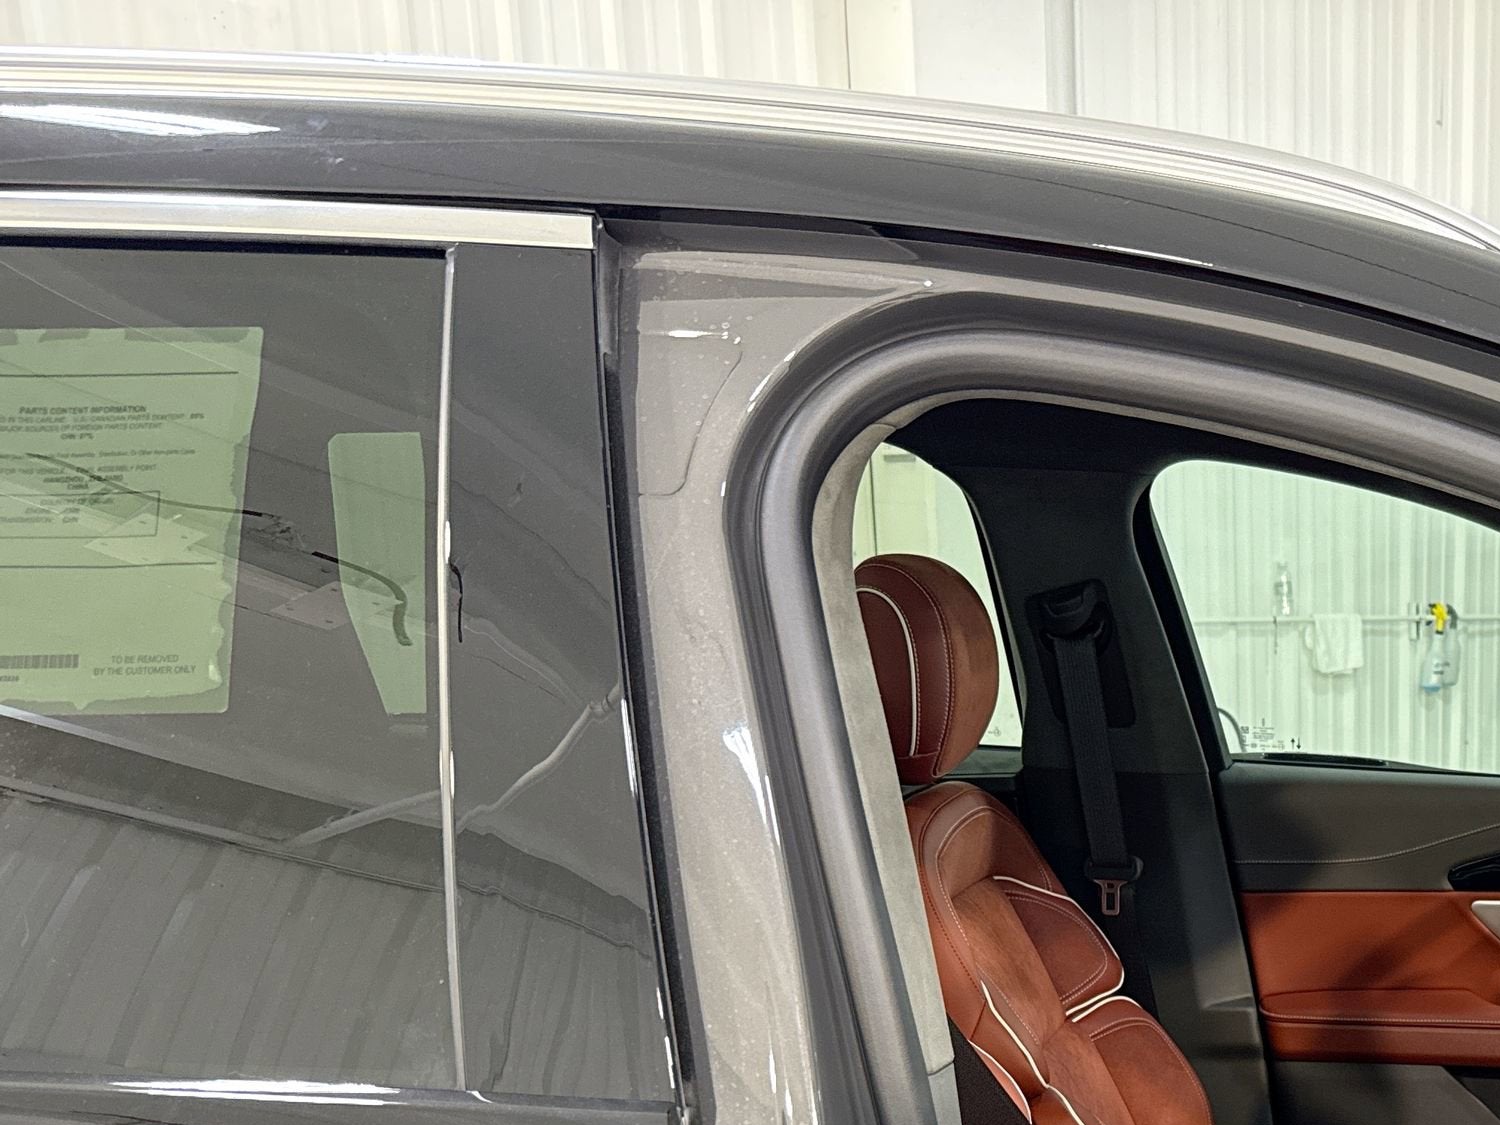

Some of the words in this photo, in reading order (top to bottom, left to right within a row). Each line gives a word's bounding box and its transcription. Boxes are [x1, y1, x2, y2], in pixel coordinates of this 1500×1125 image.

[19, 406, 48, 415] PARTS
[50, 406, 89, 415] CONTENT
[90, 405, 147, 414] INFORMATION
[111, 655, 123, 664] TO
[124, 655, 136, 663] BE
[137, 654, 179, 663] REMOVED
[93, 667, 105, 676] BY
[107, 667, 123, 675] THE
[125, 666, 172, 675] CUSTOMER
[174, 665, 197, 674] ONLY
